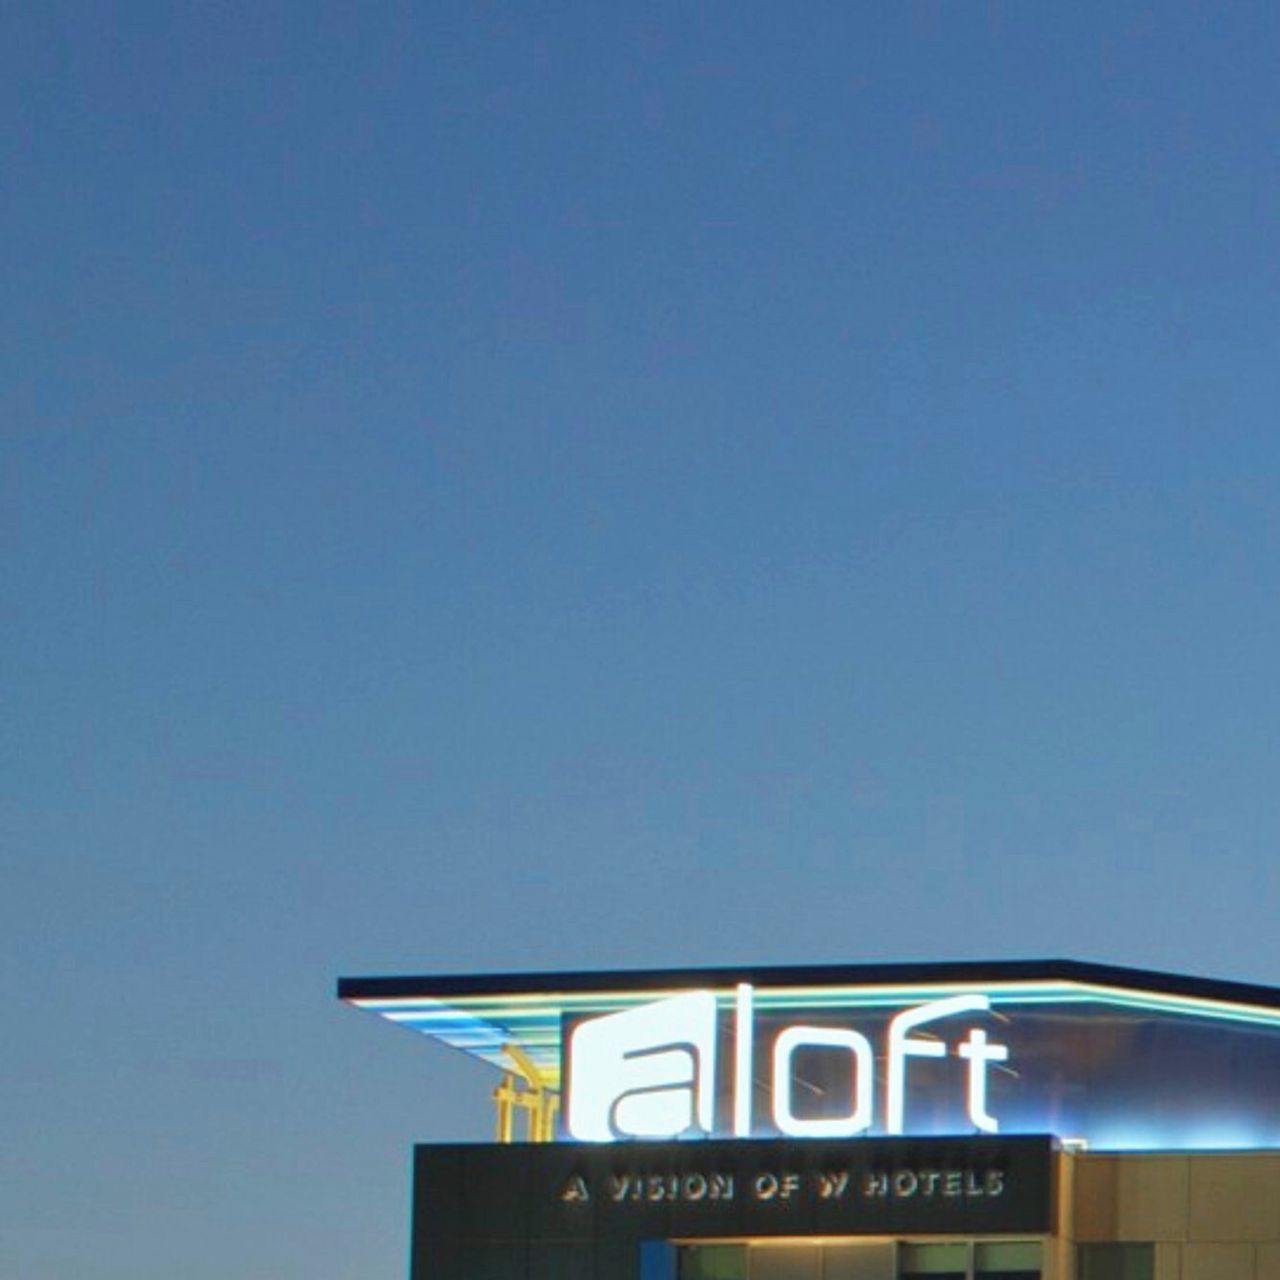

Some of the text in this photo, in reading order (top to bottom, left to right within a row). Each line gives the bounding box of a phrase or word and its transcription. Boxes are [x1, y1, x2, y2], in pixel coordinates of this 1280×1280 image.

[567, 983, 1007, 1141] aloft
[563, 1169, 1005, 1200] A VISION OF W HOTELS
